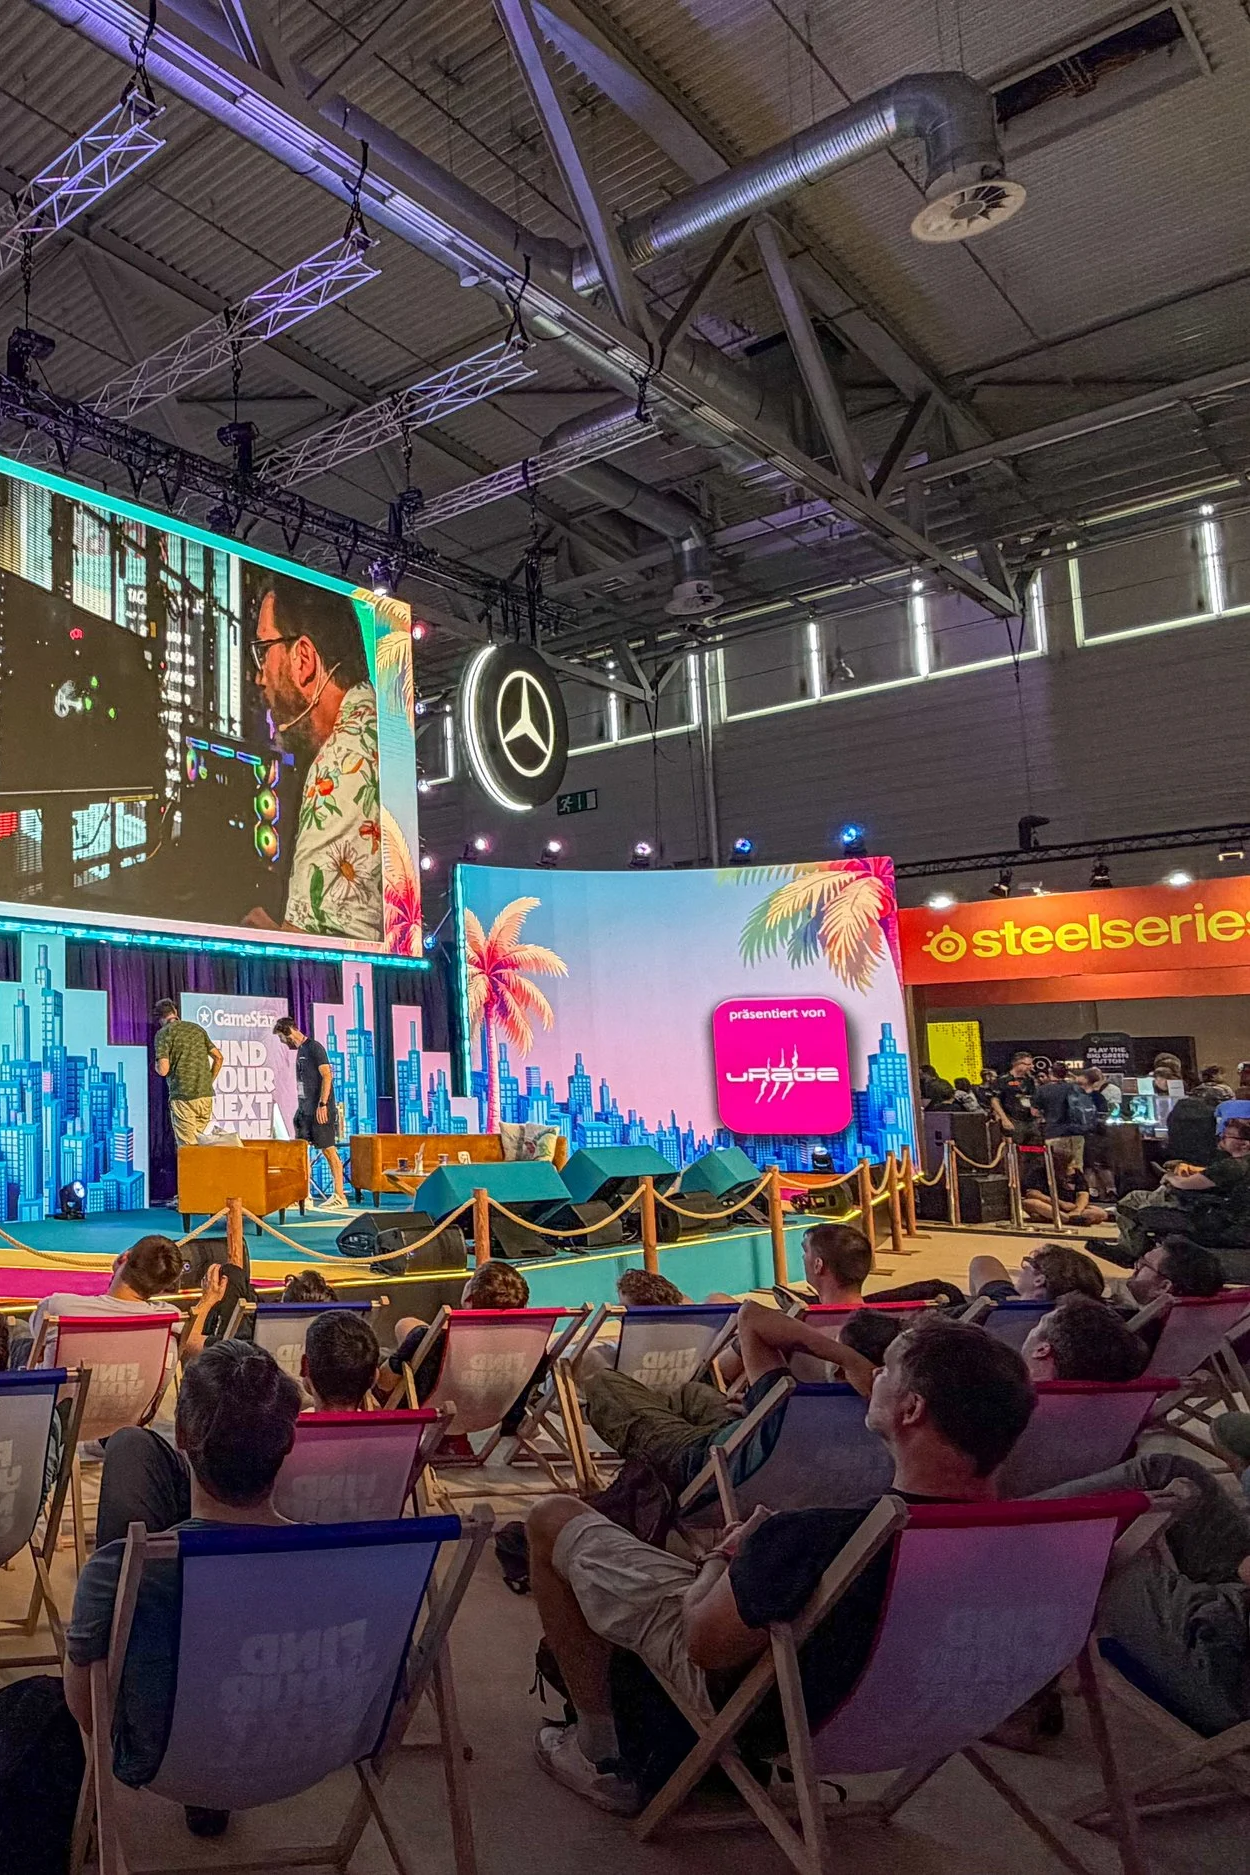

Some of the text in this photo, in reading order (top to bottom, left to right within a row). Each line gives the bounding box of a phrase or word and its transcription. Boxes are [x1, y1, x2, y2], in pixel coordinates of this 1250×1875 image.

[972, 903, 1250, 958] steelserie
[213, 1009, 276, 1028] GameStar
[729, 1008, 826, 1022] präsentiert von
[212, 1066, 276, 1094] OUR
